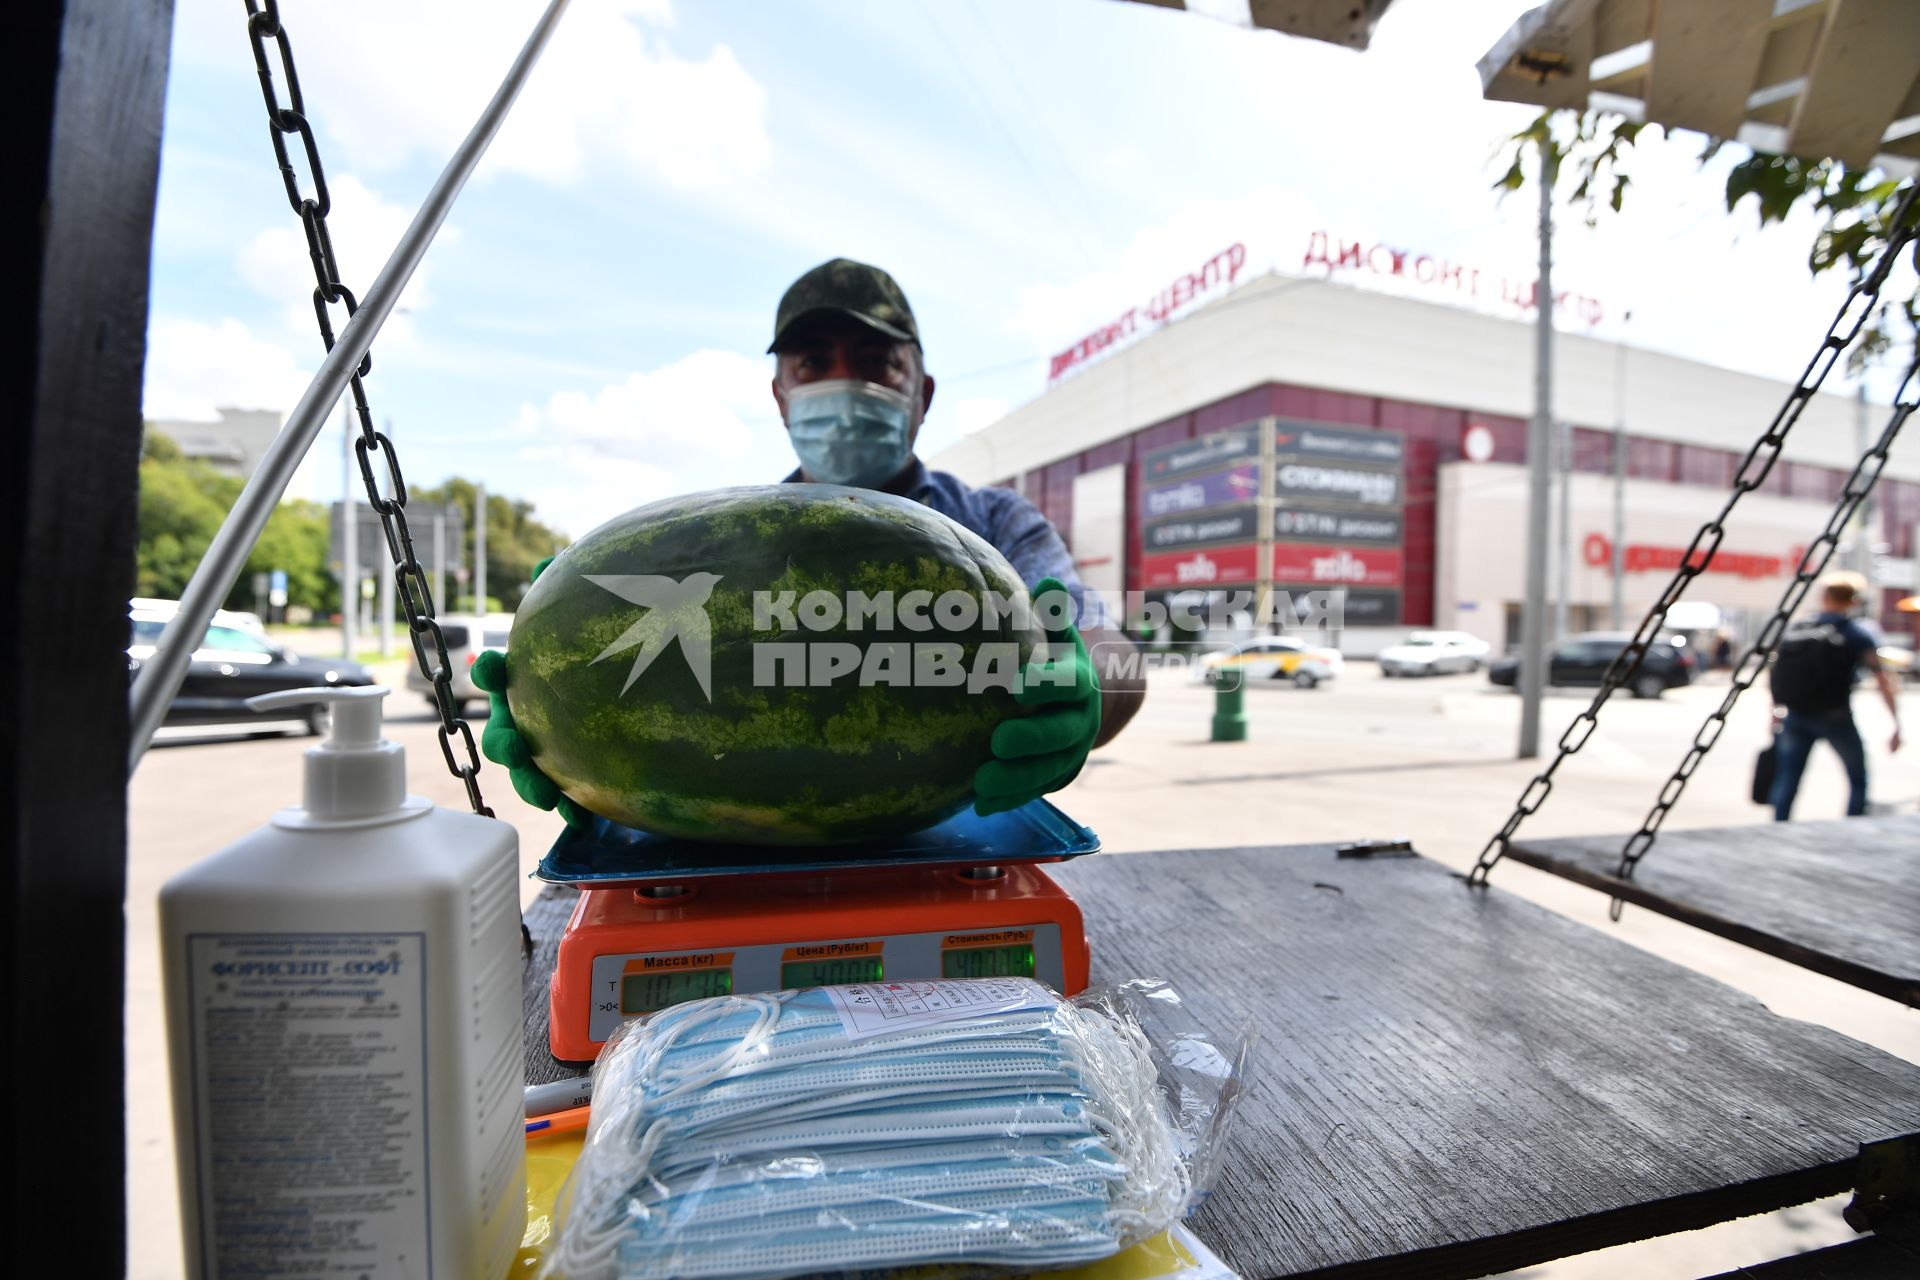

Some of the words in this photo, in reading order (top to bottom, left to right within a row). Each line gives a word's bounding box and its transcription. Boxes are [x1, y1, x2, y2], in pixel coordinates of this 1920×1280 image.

[948, 932, 1001, 944] Стоимость
[797, 945, 825, 957] Цена
[827, 941, 869, 955] (Руб/кг)
[644, 955, 689, 968] Масса
[692, 953, 714, 966] (кг)
